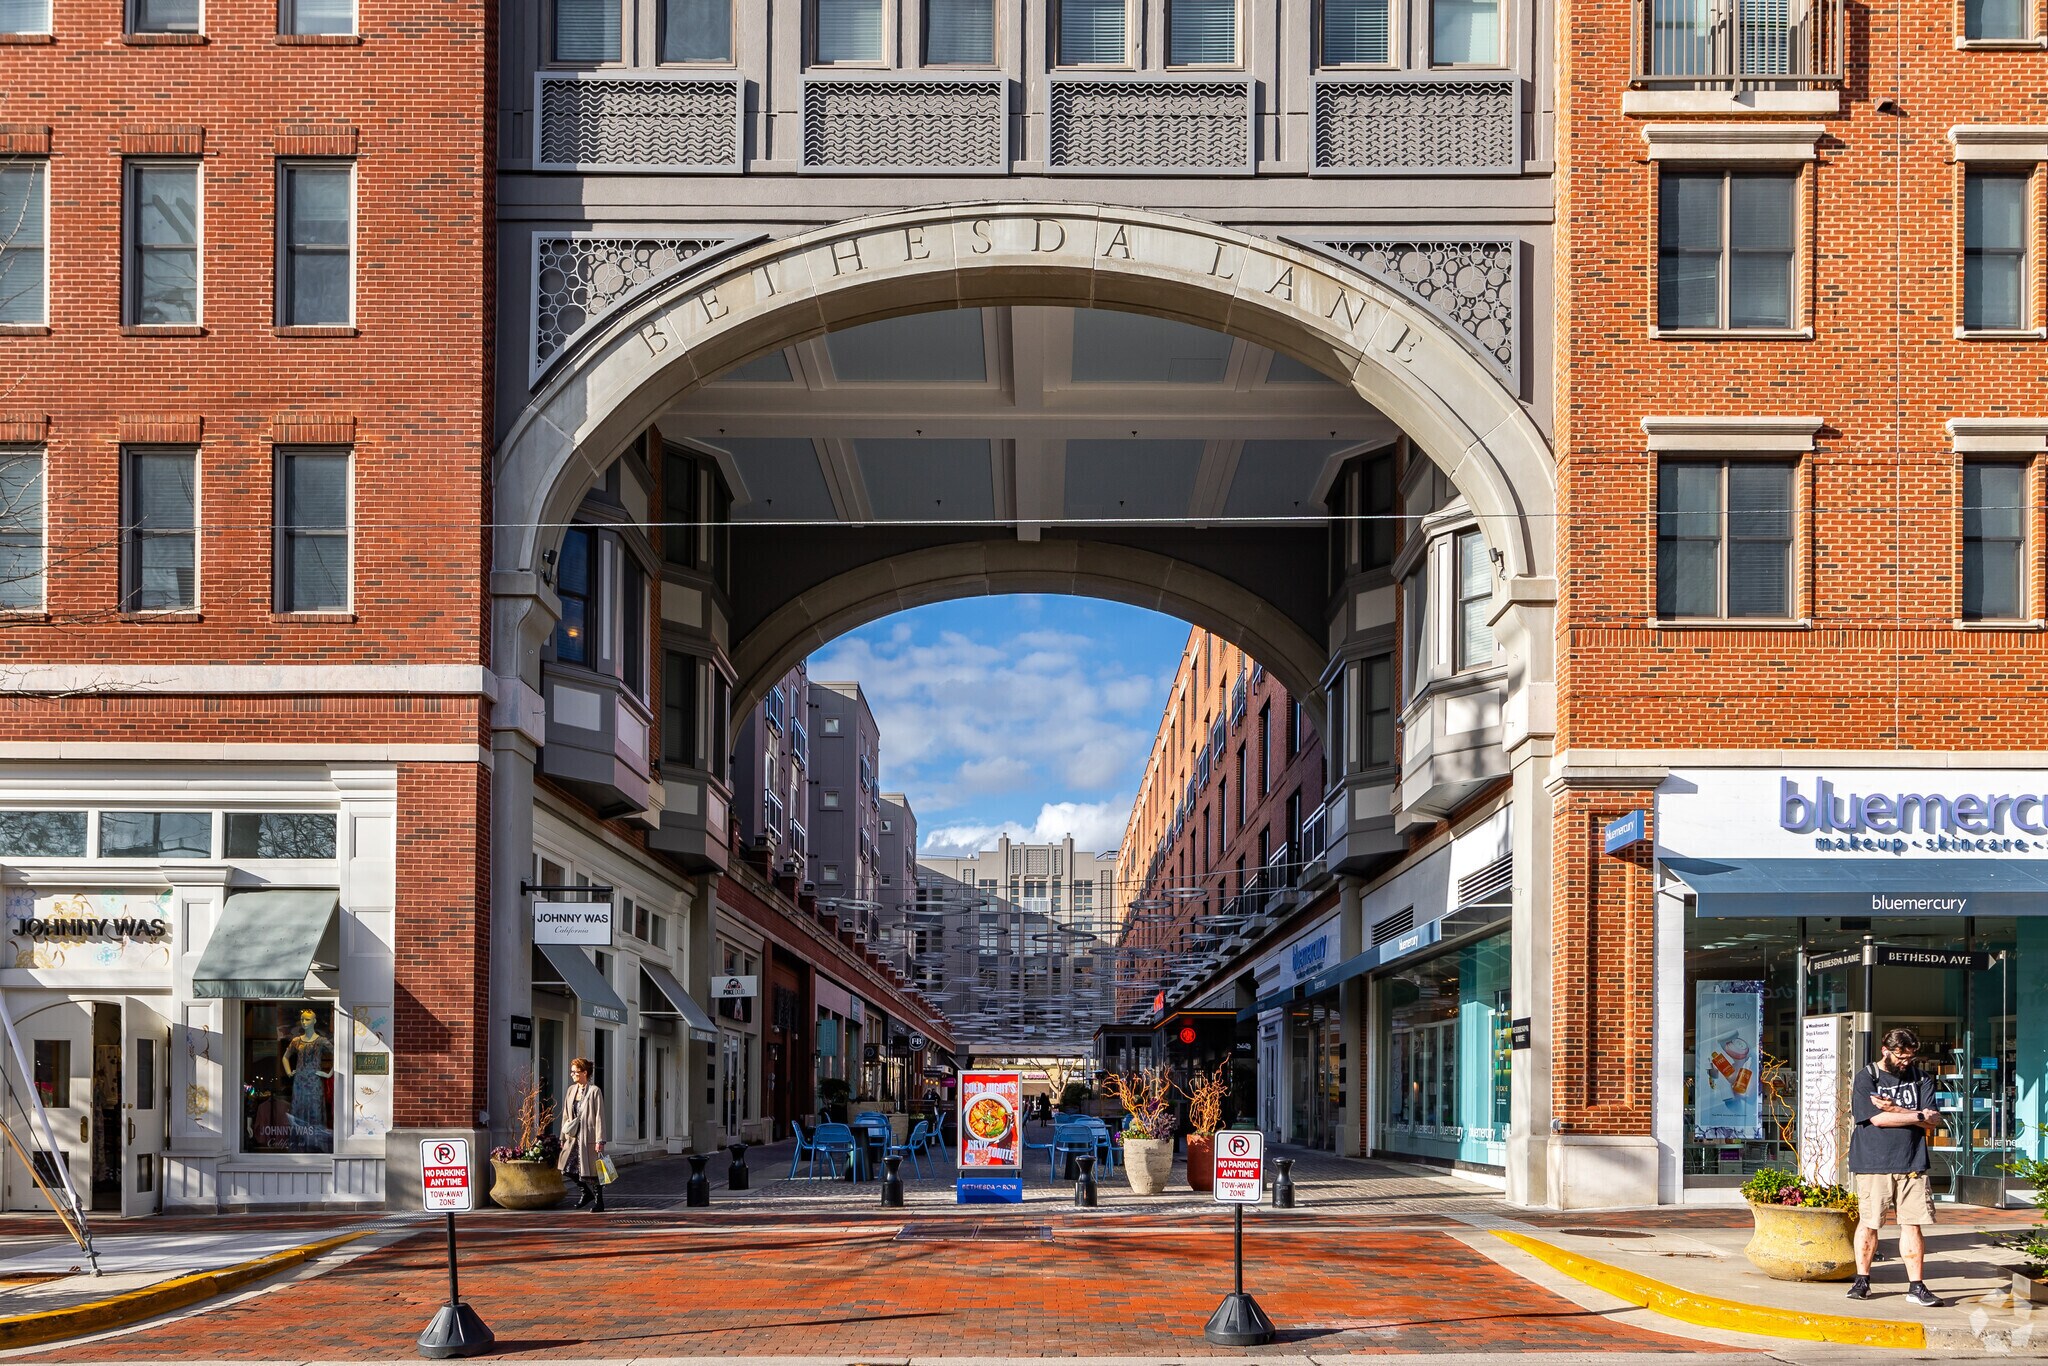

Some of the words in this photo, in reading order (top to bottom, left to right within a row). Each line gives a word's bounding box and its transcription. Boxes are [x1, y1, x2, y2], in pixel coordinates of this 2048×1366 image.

[633, 217, 1136, 358] BETHESDA
[1206, 241, 1423, 364] LANE
[1780, 776, 2048, 831] bluemerc
[1815, 834, 1904, 854] makeup
[1925, 834, 2025, 851] skincare
[1871, 894, 1967, 913] bluemercury
[537, 914, 582, 923] JOHNNY
[584, 914, 609, 923] WAS
[12, 918, 108, 937] JOHNNY
[113, 918, 166, 937] WAS
[554, 925, 589, 936] California
[1813, 956, 1843, 971] BETHESDA
[1843, 953, 1861, 965] LANE
[1888, 952, 1947, 964] BETHESDA
[1949, 955, 1972, 965] AVE
[1708, 1011, 1724, 1019] rms
[1726, 1010, 1751, 1021] beauty
[964, 1083, 985, 1094] COLD
[260, 1126, 293, 1136] JOHNNY
[295, 1126, 314, 1135] WAS
[1218, 1160, 1227, 1168] NO
[1228, 1160, 1258, 1169] PARKING
[425, 1169, 434, 1177] NO
[436, 1168, 466, 1177] PARKING
[1238, 1170, 1254, 1178] TIME
[430, 1190, 463, 1198] TOW-AWAY
[1229, 1189, 1246, 1197] ZONE
